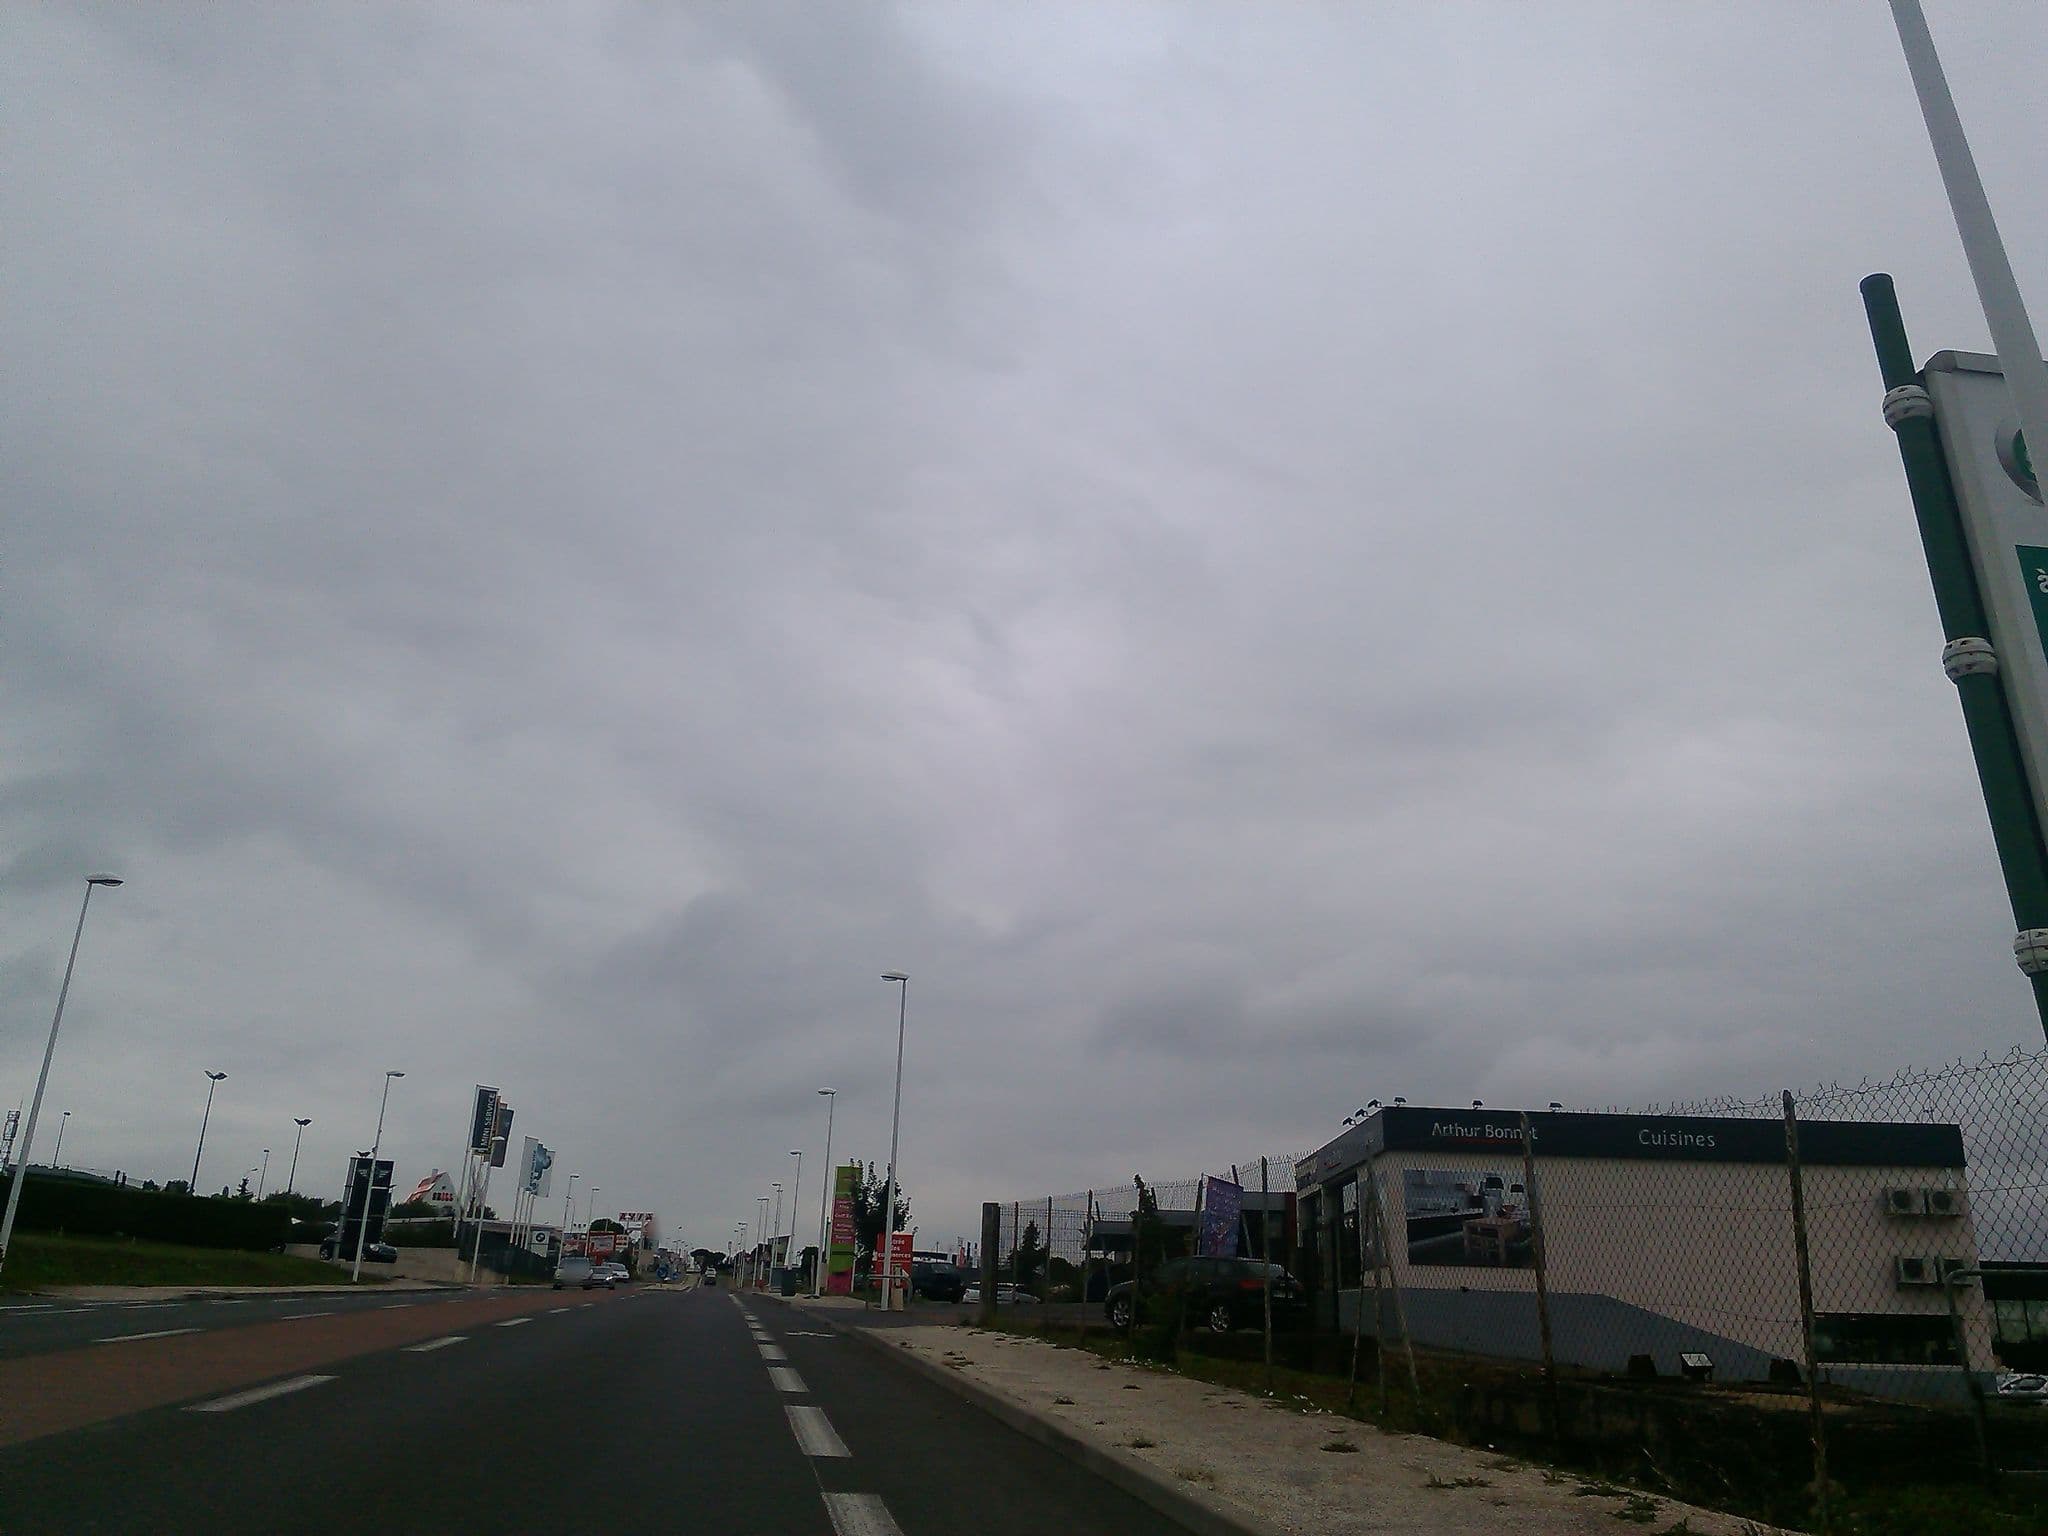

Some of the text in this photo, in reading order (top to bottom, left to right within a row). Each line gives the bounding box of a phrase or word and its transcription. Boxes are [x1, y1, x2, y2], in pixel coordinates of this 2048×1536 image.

[484, 1093, 496, 1125] SERVICE
[1431, 1121, 1539, 1140] Arthur Bonnt
[1638, 1129, 1716, 1147] Cuisines
